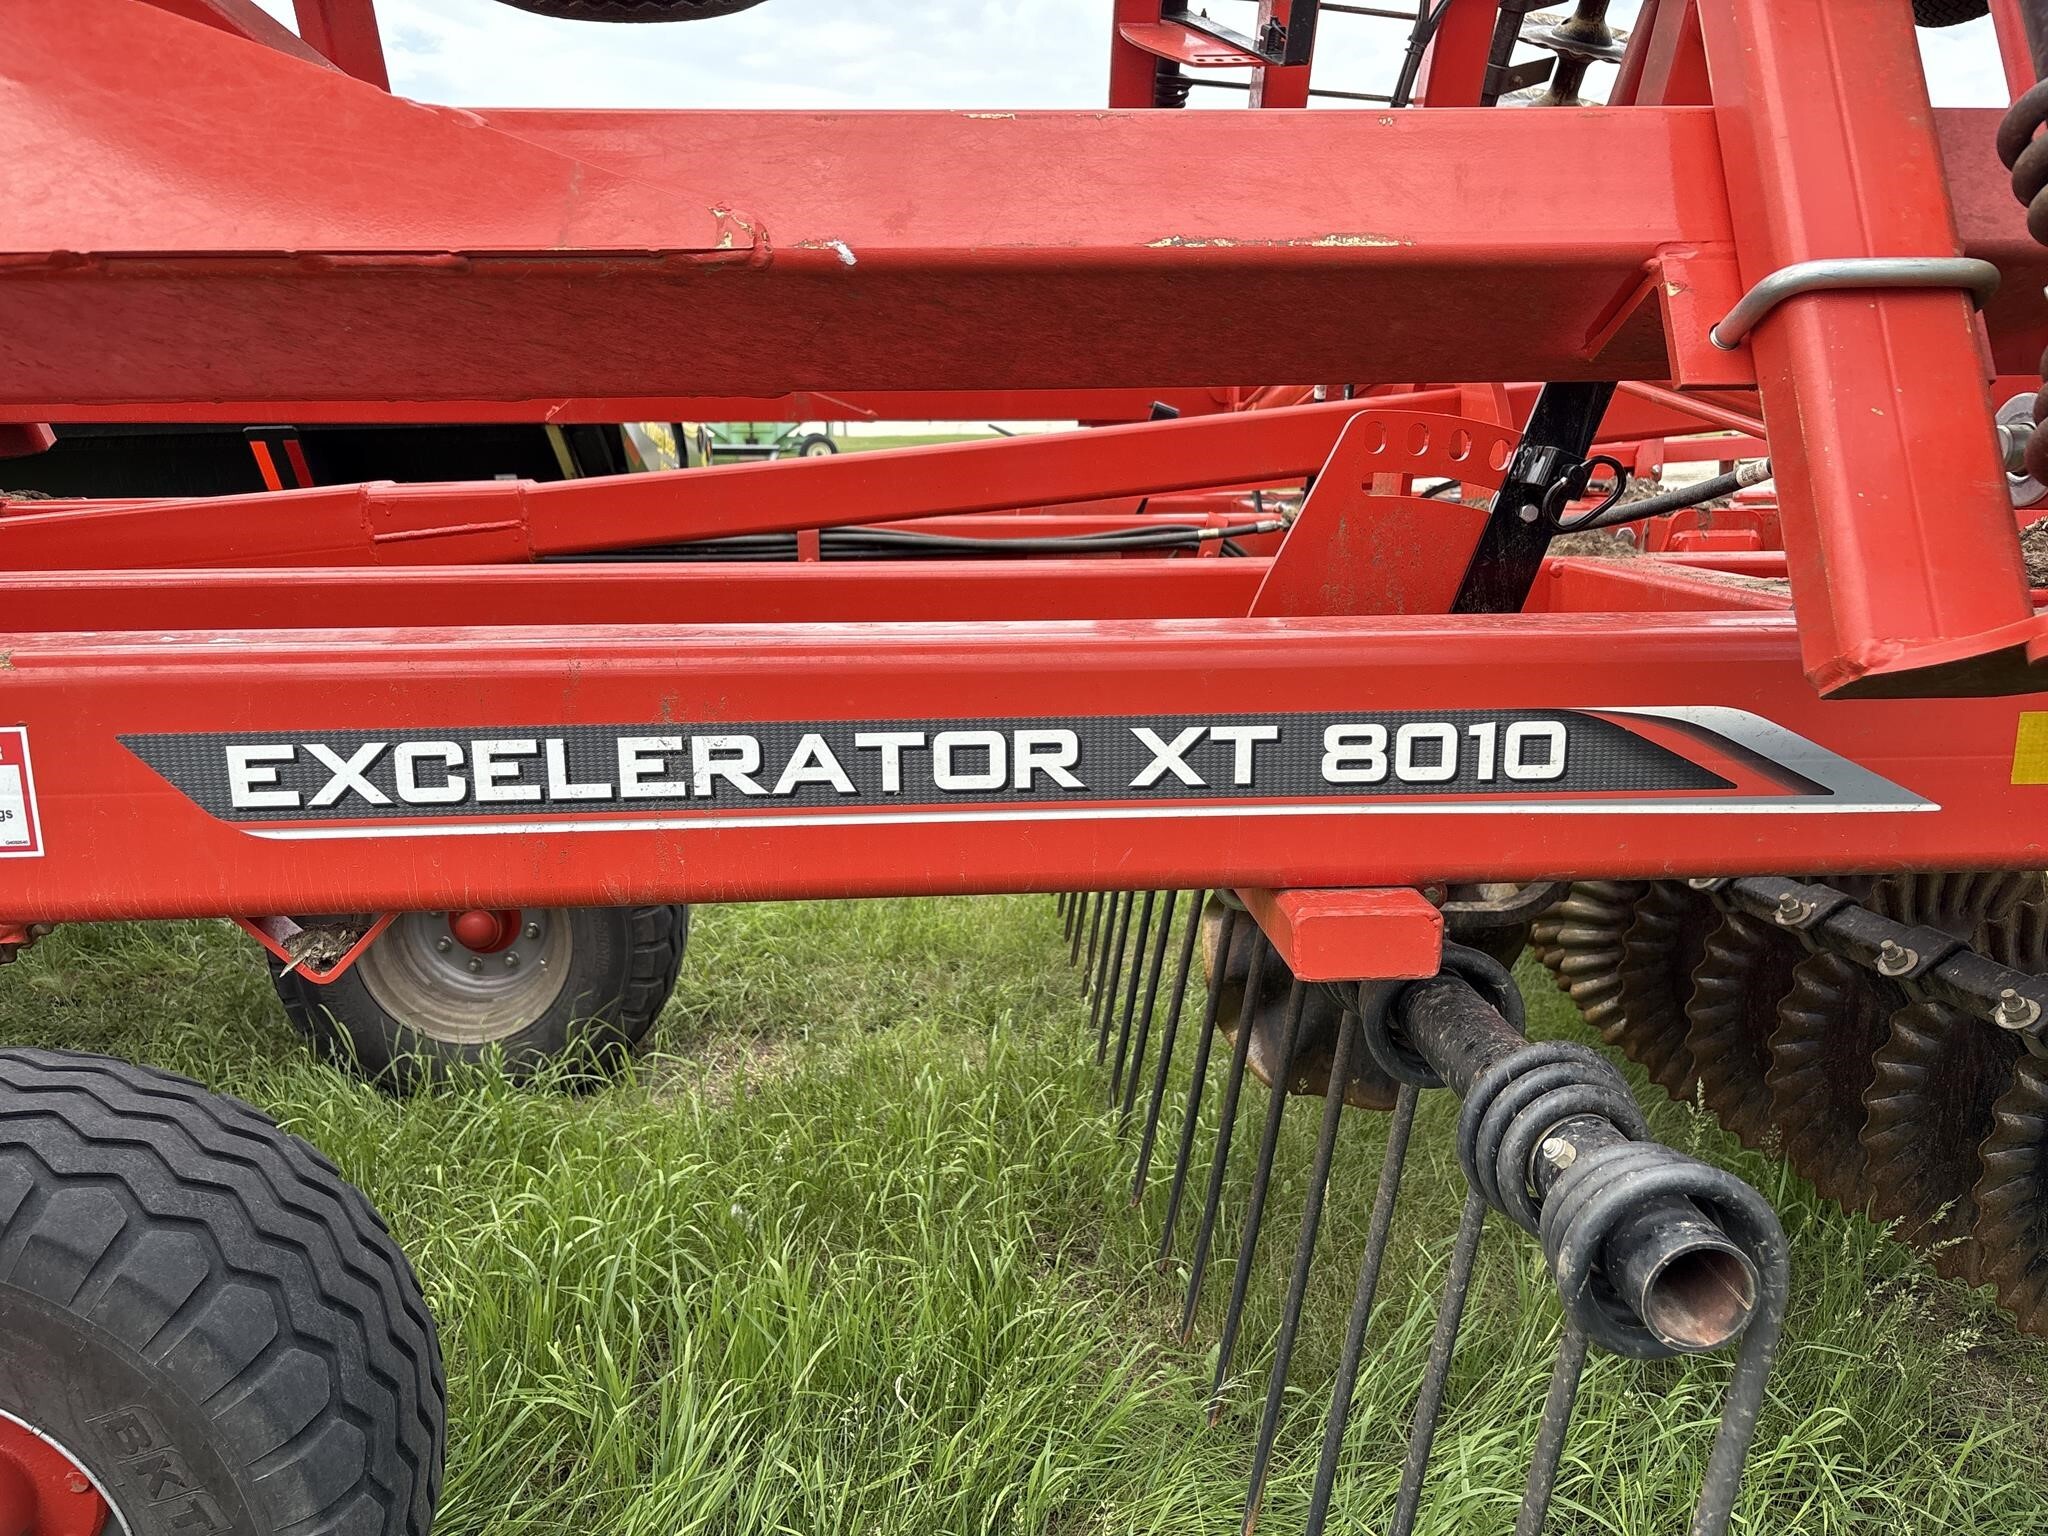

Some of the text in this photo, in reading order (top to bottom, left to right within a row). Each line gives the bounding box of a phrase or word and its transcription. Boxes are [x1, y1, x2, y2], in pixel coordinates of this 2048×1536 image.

[225, 719, 1568, 808] EXCELERATOR XT 8010
[97, 1407, 222, 1533] BKT
